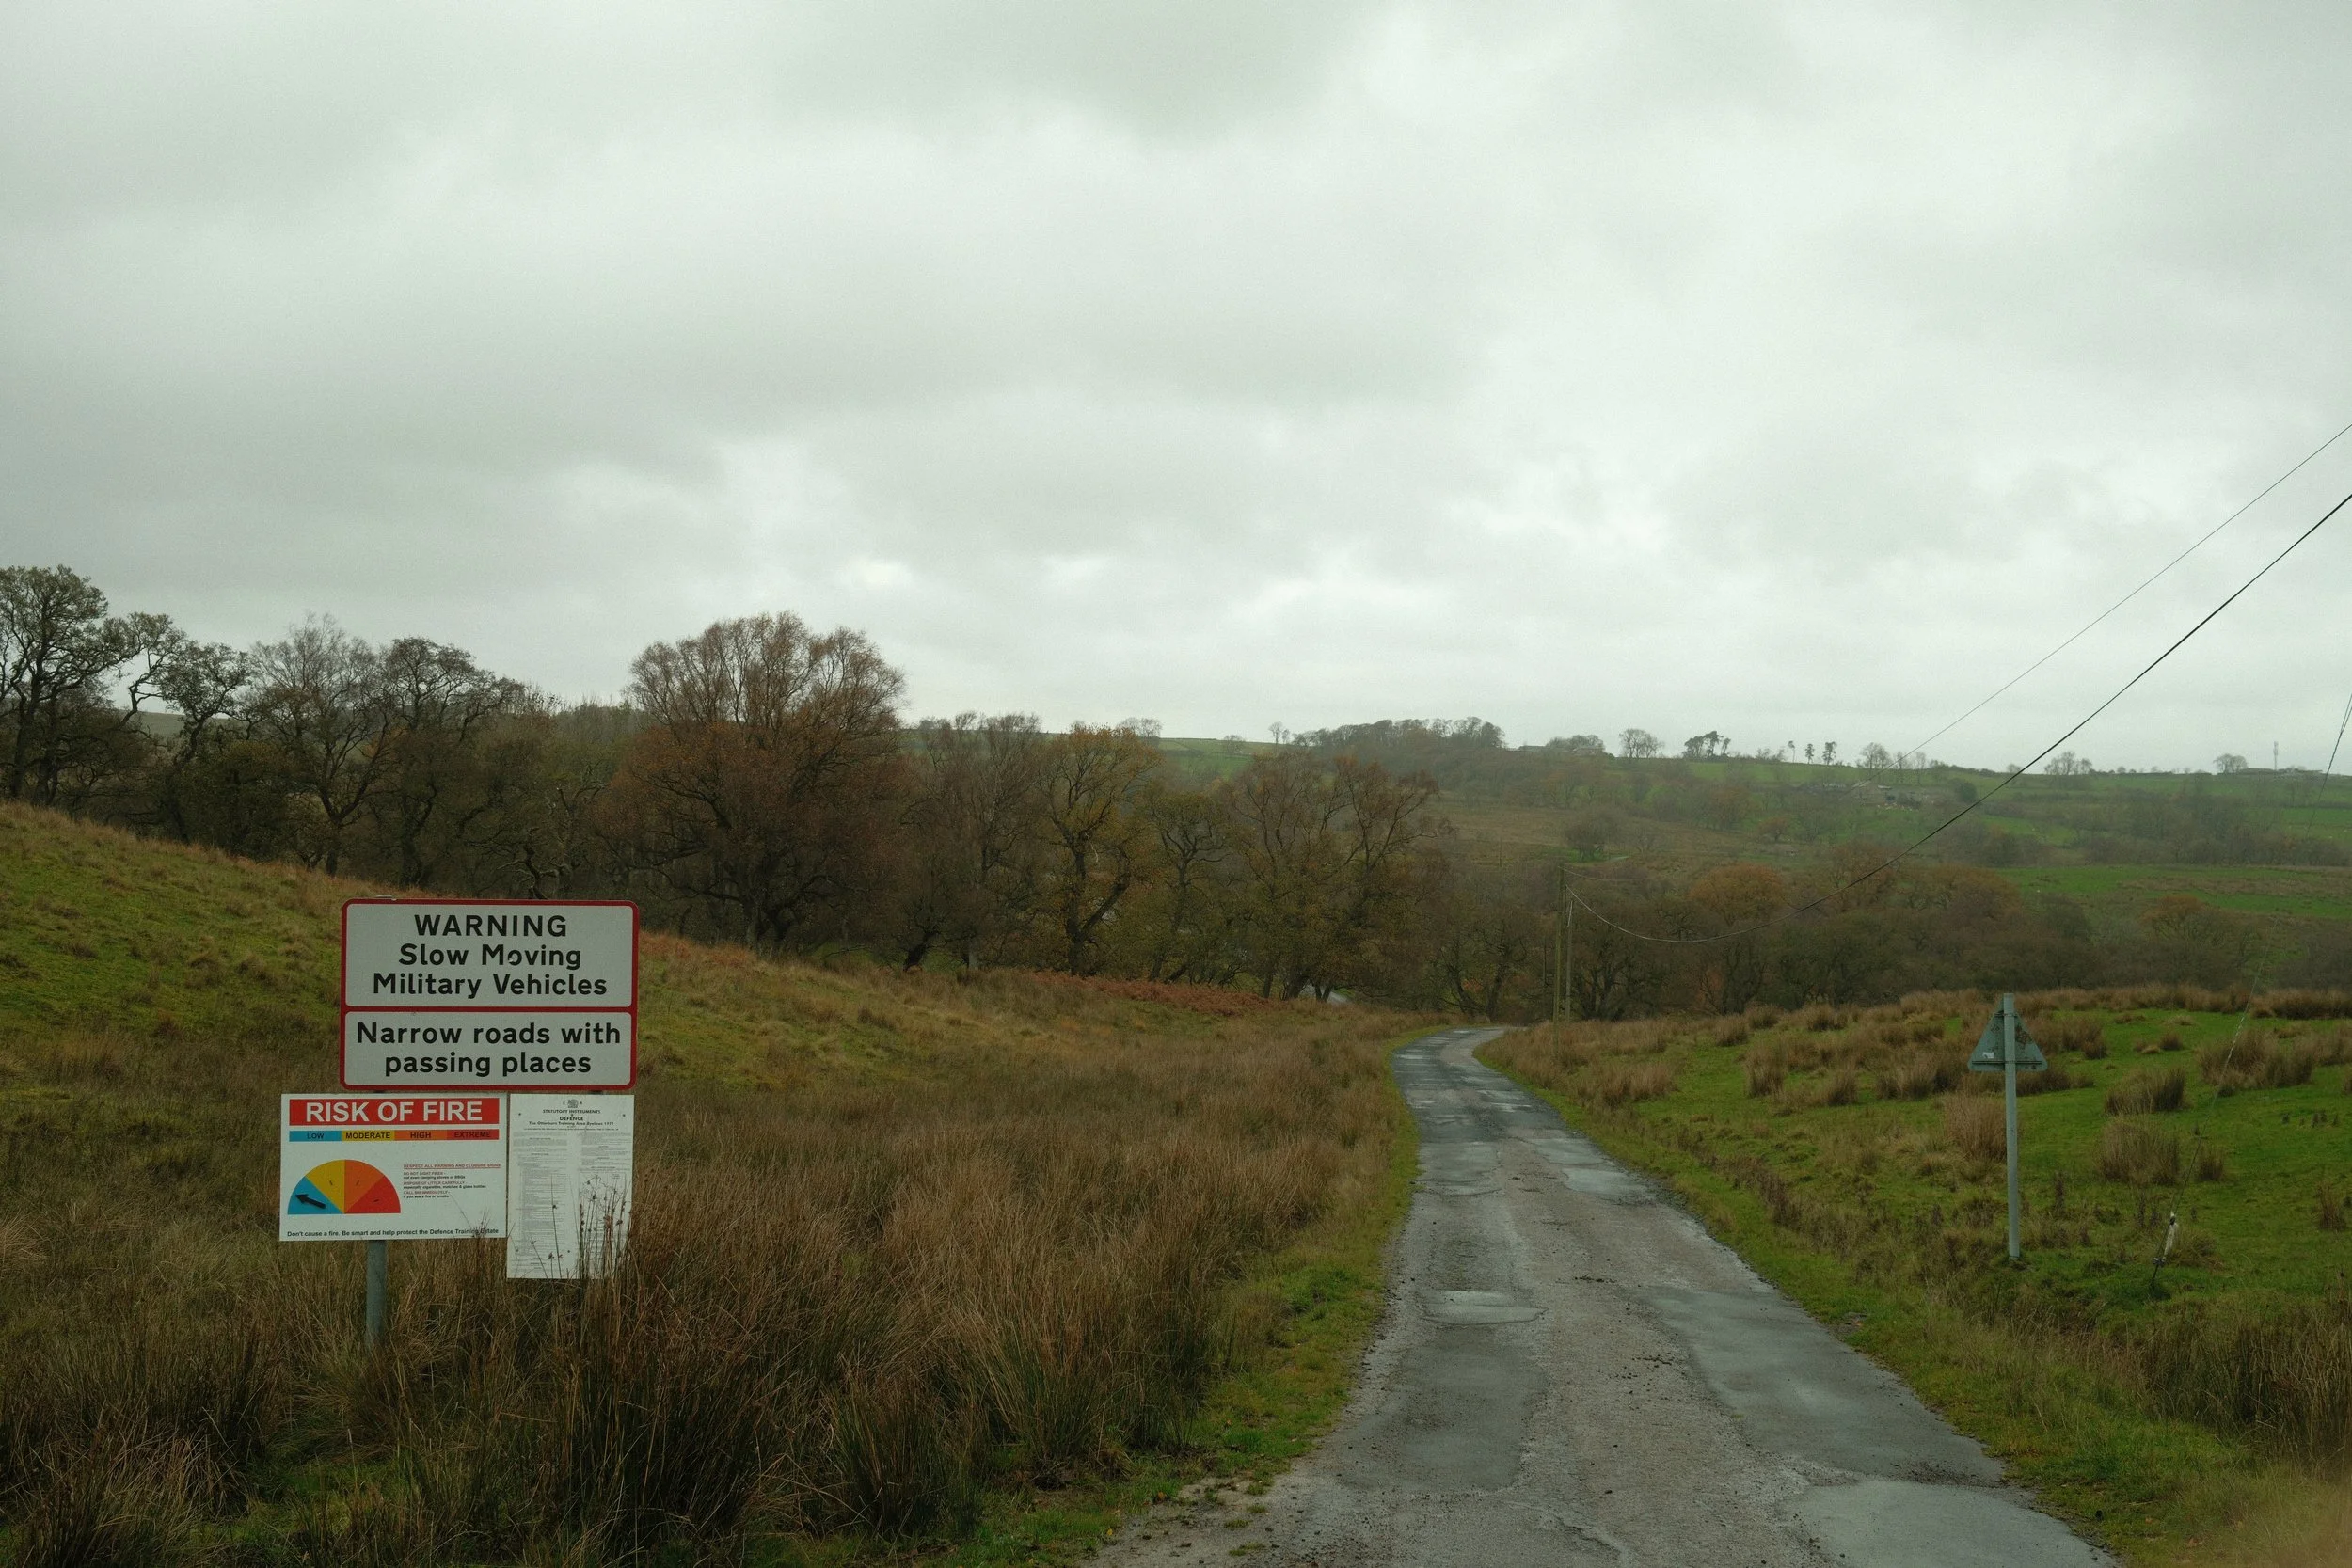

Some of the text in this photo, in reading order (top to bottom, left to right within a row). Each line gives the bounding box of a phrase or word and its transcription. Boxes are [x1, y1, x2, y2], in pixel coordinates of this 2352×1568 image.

[415, 914, 566, 937] WARNING
[399, 943, 581, 970] Slow Moving
[373, 973, 608, 999] Military Vehicles
[357, 1022, 620, 1044] Narrow roads with
[385, 1052, 592, 1077] passing places
[306, 1101, 483, 1122] RISK OF FIRE
